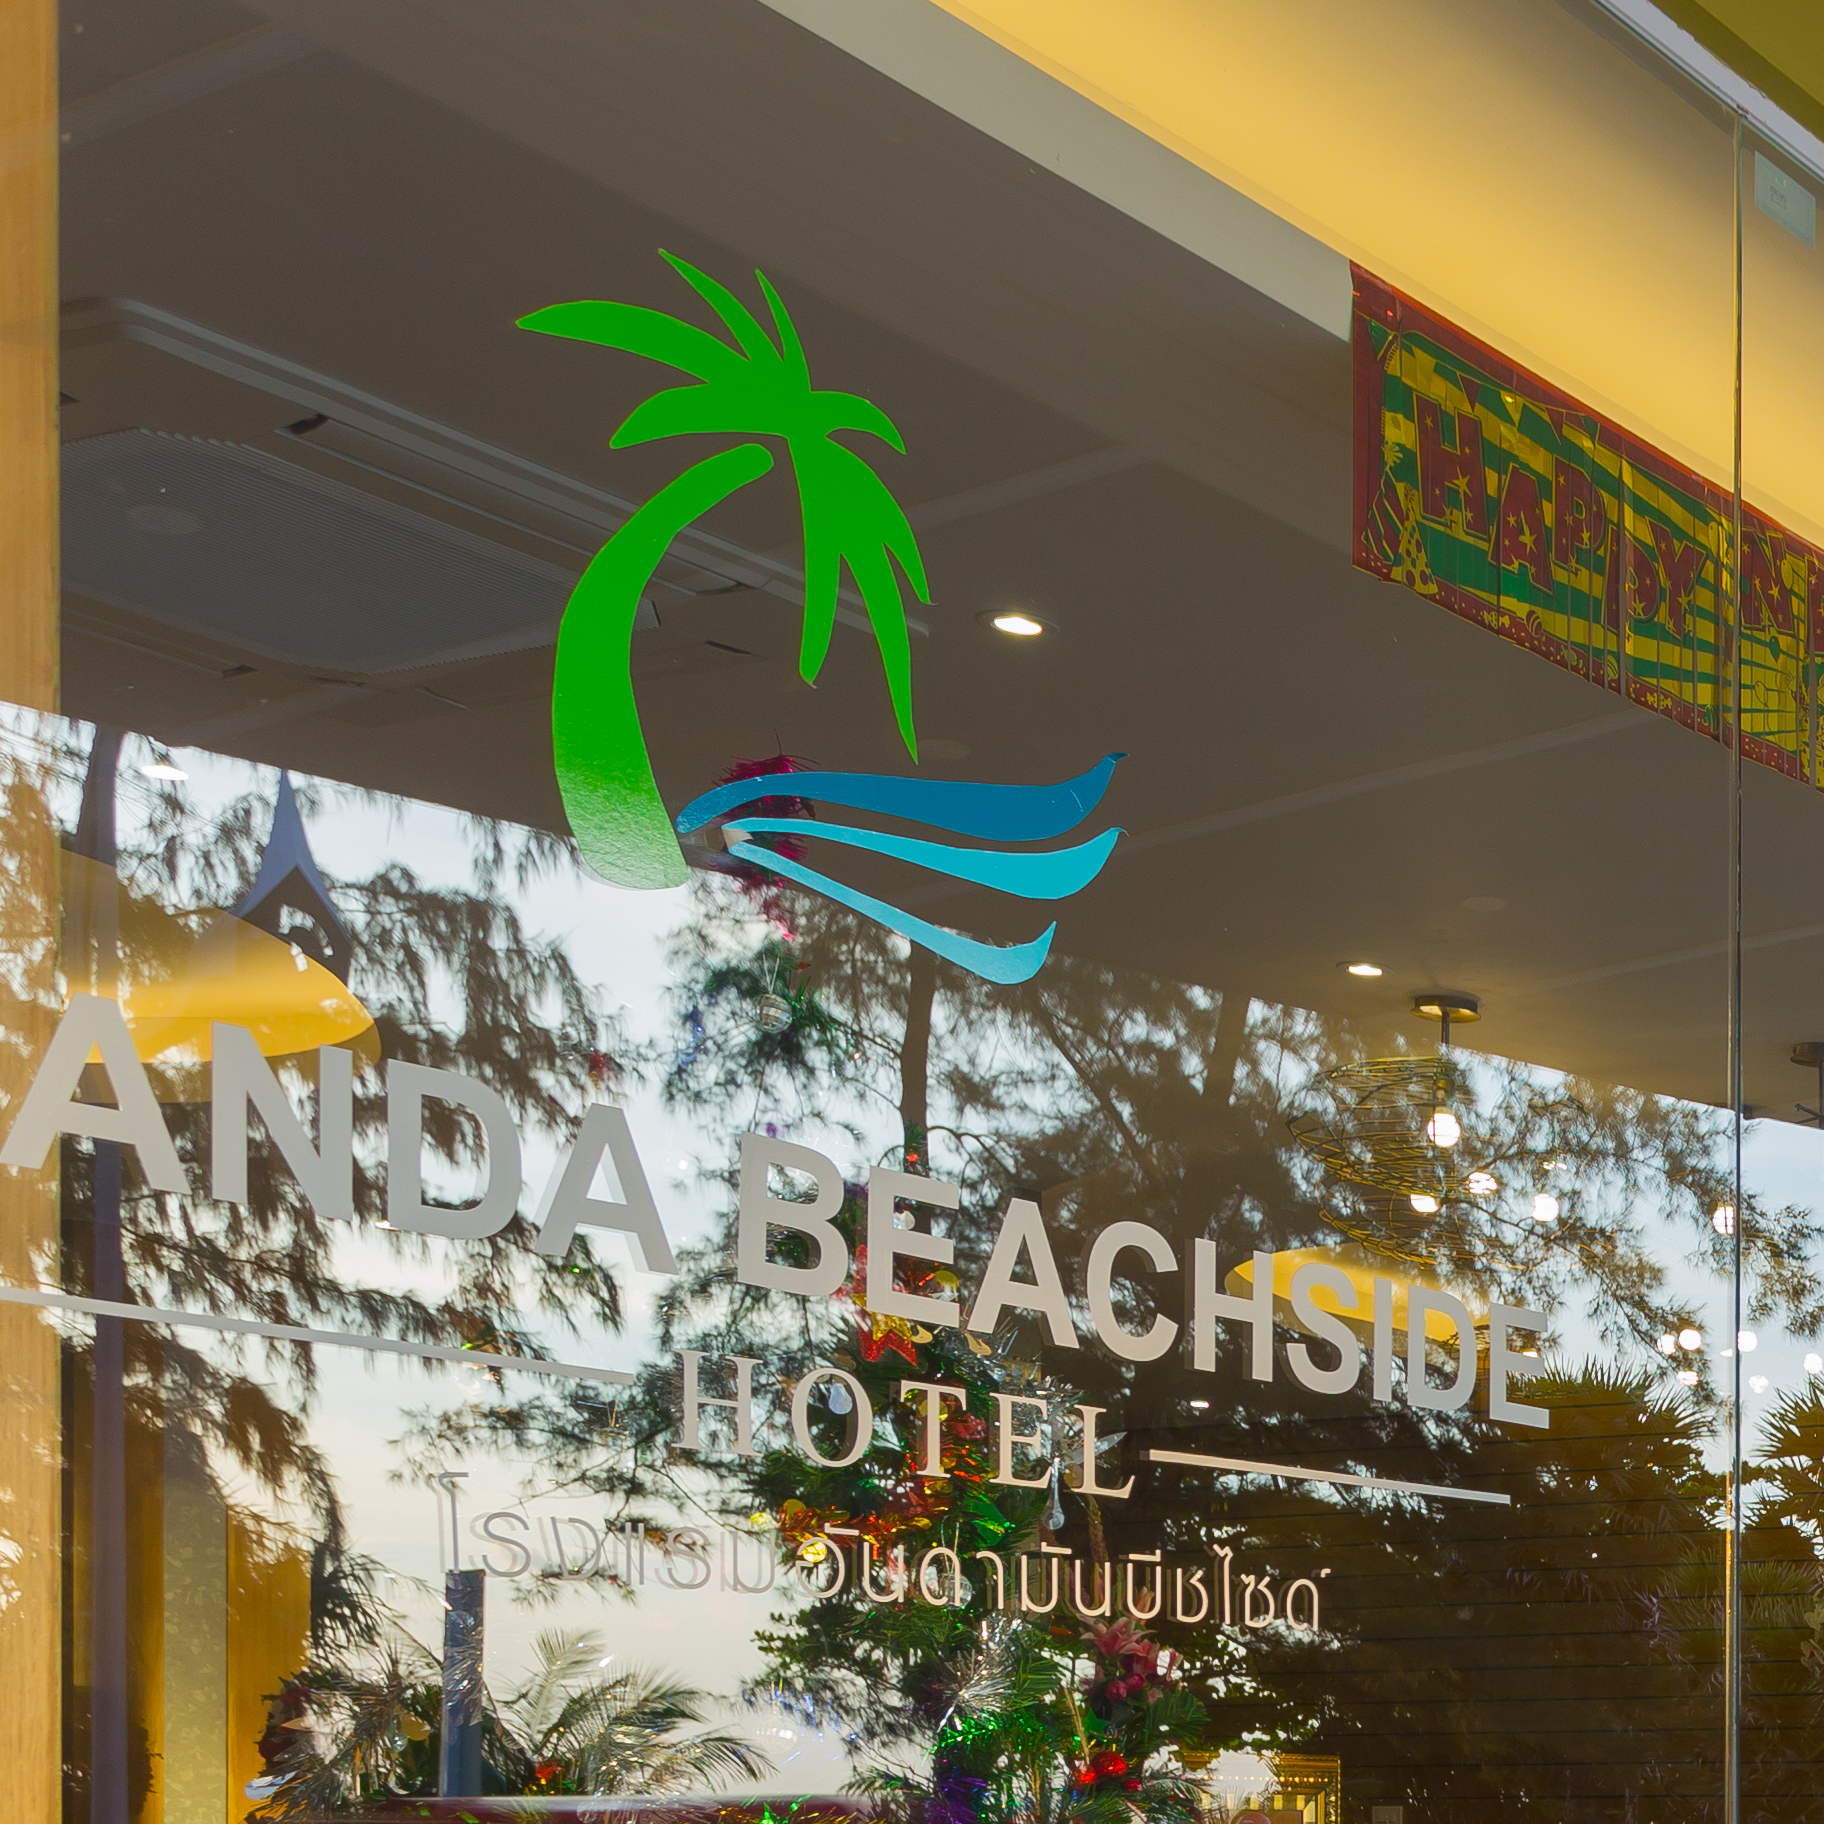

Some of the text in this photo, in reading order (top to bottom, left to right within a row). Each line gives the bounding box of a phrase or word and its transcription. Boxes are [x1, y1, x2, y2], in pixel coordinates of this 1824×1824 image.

[1412, 388, 1711, 642] HAPPY
[0, 992, 1551, 1430] ANDA BEACHSIDE
[671, 1348, 1136, 1499] HOTEL
